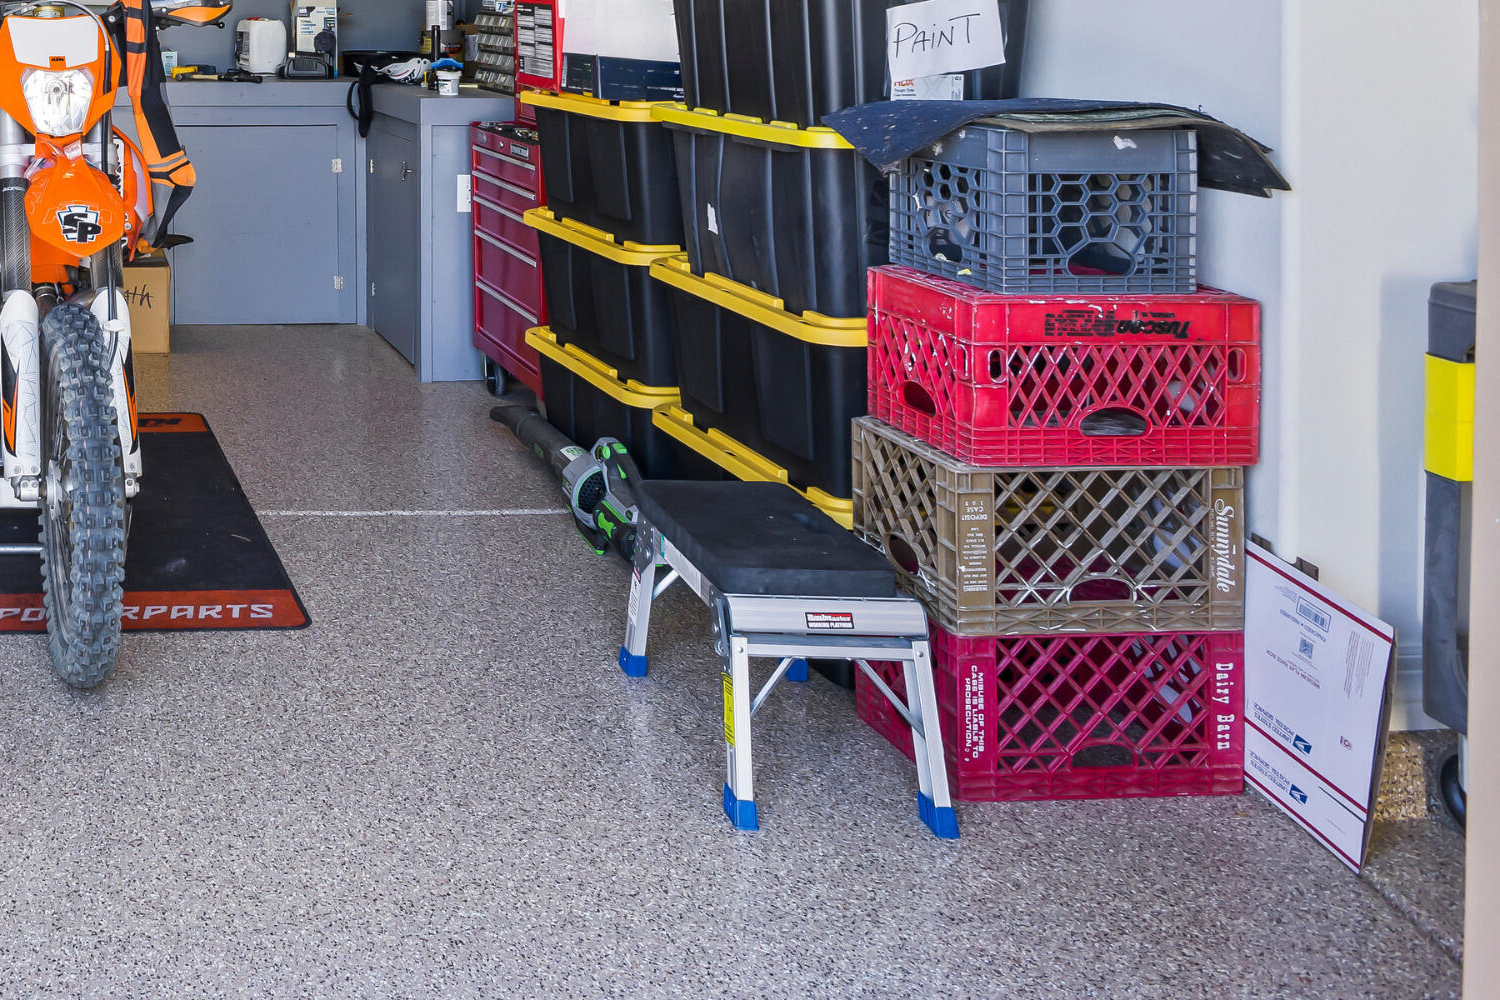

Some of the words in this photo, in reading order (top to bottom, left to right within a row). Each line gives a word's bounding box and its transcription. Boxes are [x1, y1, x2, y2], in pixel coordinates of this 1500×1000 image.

[1212, 663, 1234, 704] Dairy
[978, 713, 984, 727] OF
[1253, 702, 1274, 720] SERVICE
[1254, 711, 1272, 728] STATES
[1217, 714, 1235, 749] Barn
[1271, 726, 1292, 743] UNITED
[1275, 718, 1294, 736] POSTAL
[972, 746, 979, 758] TO
[1249, 750, 1270, 769] SERVICE
[1250, 759, 1268, 777] STATES
[1271, 767, 1290, 785] POSTAL
[1268, 775, 1289, 793] UNITED
